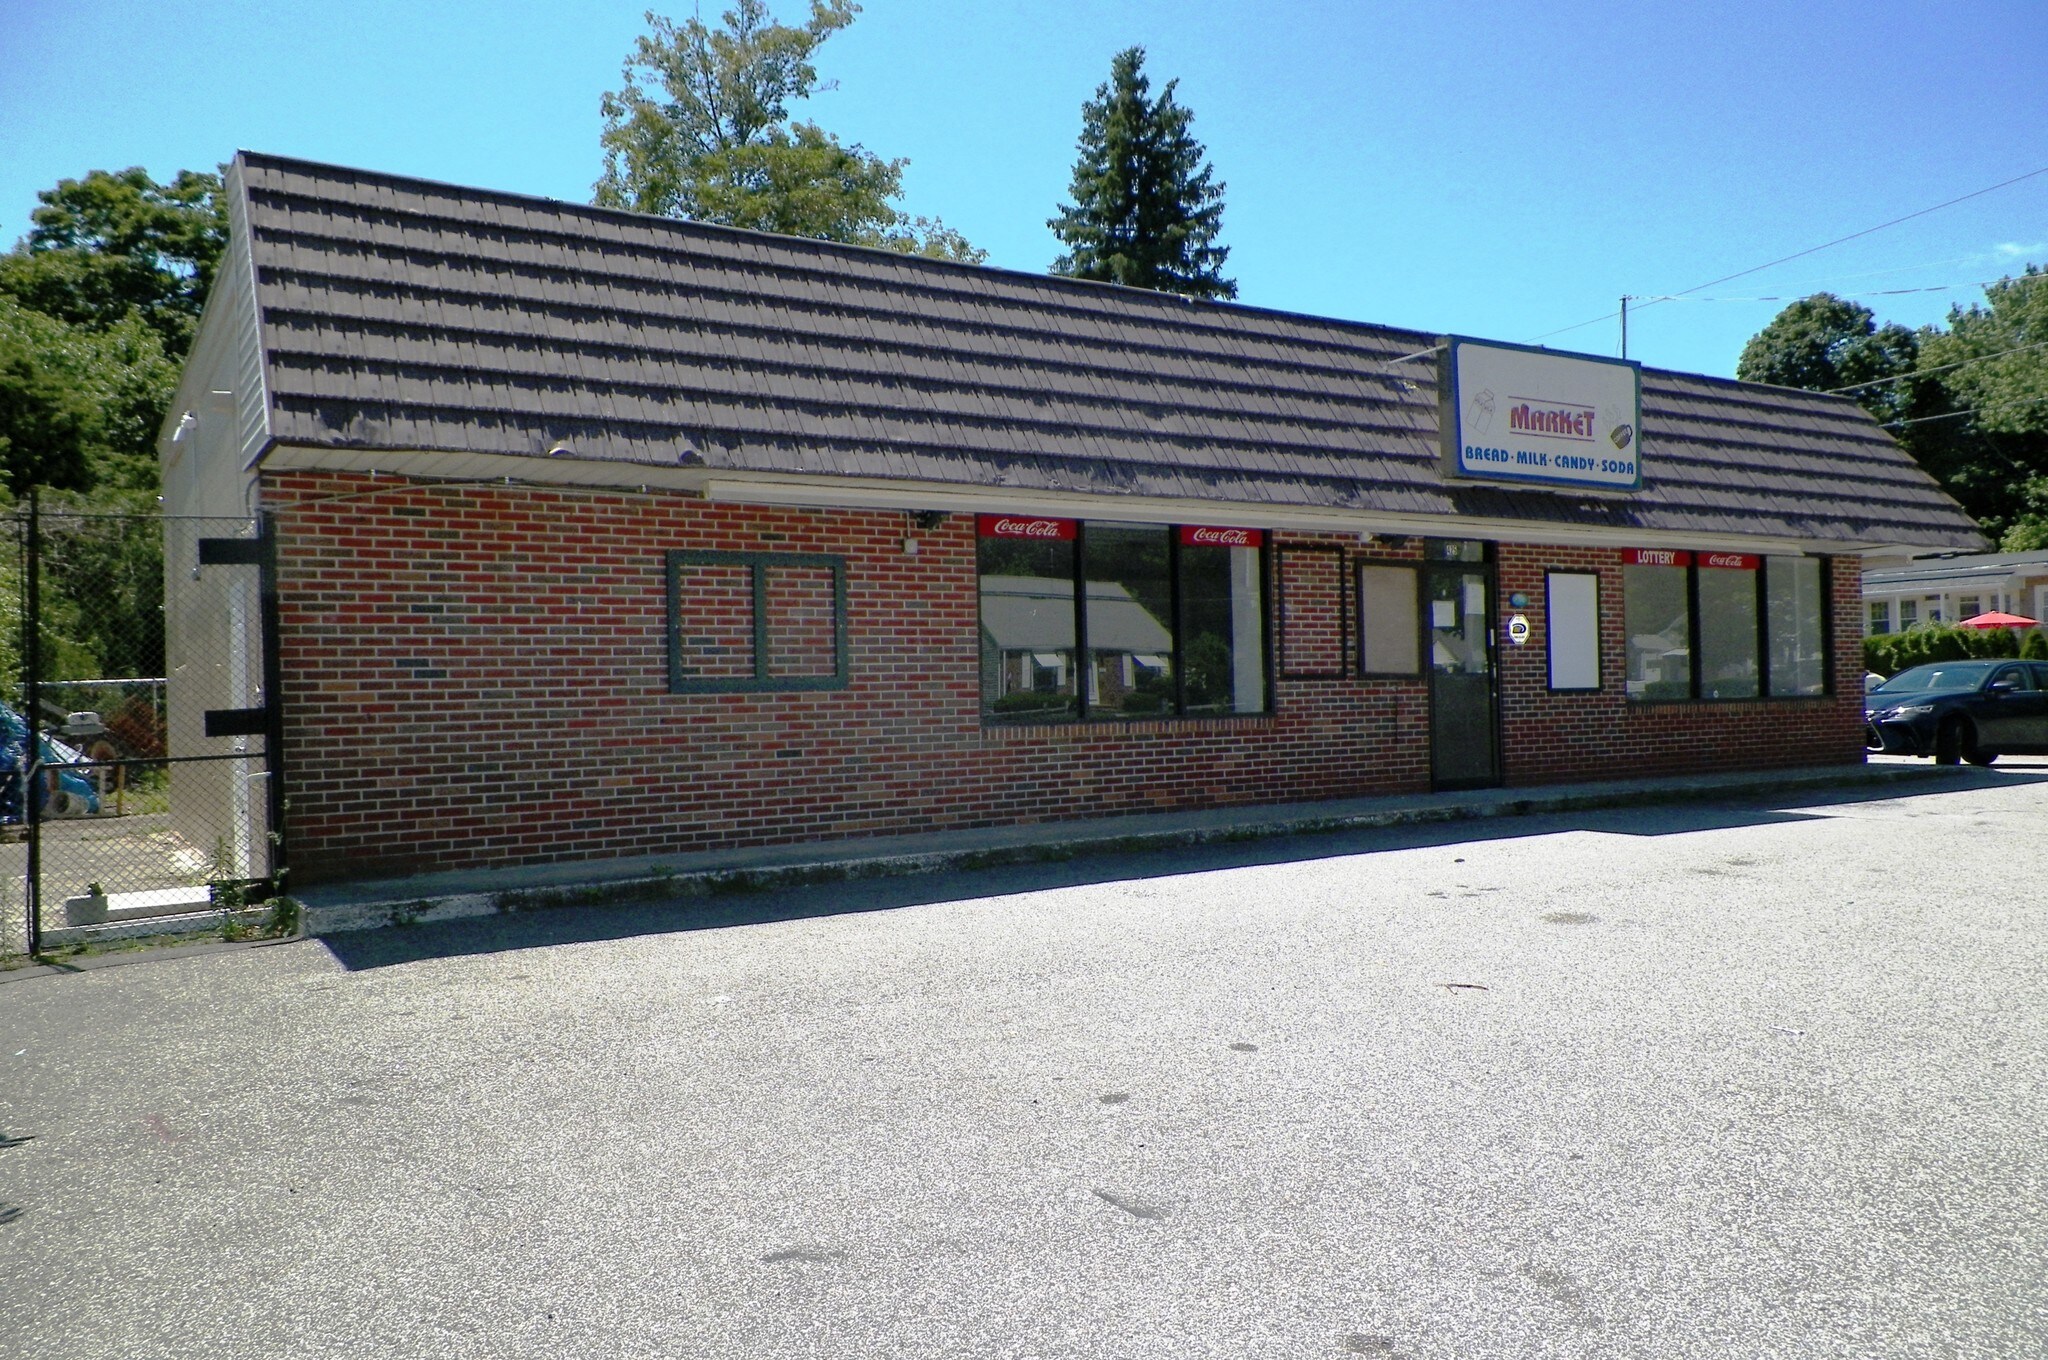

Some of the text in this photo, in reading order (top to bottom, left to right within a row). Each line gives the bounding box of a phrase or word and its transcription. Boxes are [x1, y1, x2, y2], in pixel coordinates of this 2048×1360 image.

[1510, 403, 1595, 437] MARKET
[1465, 445, 1634, 475] BREAD MILK CANDY SODA
[1637, 550, 1675, 565] LOTTERY
